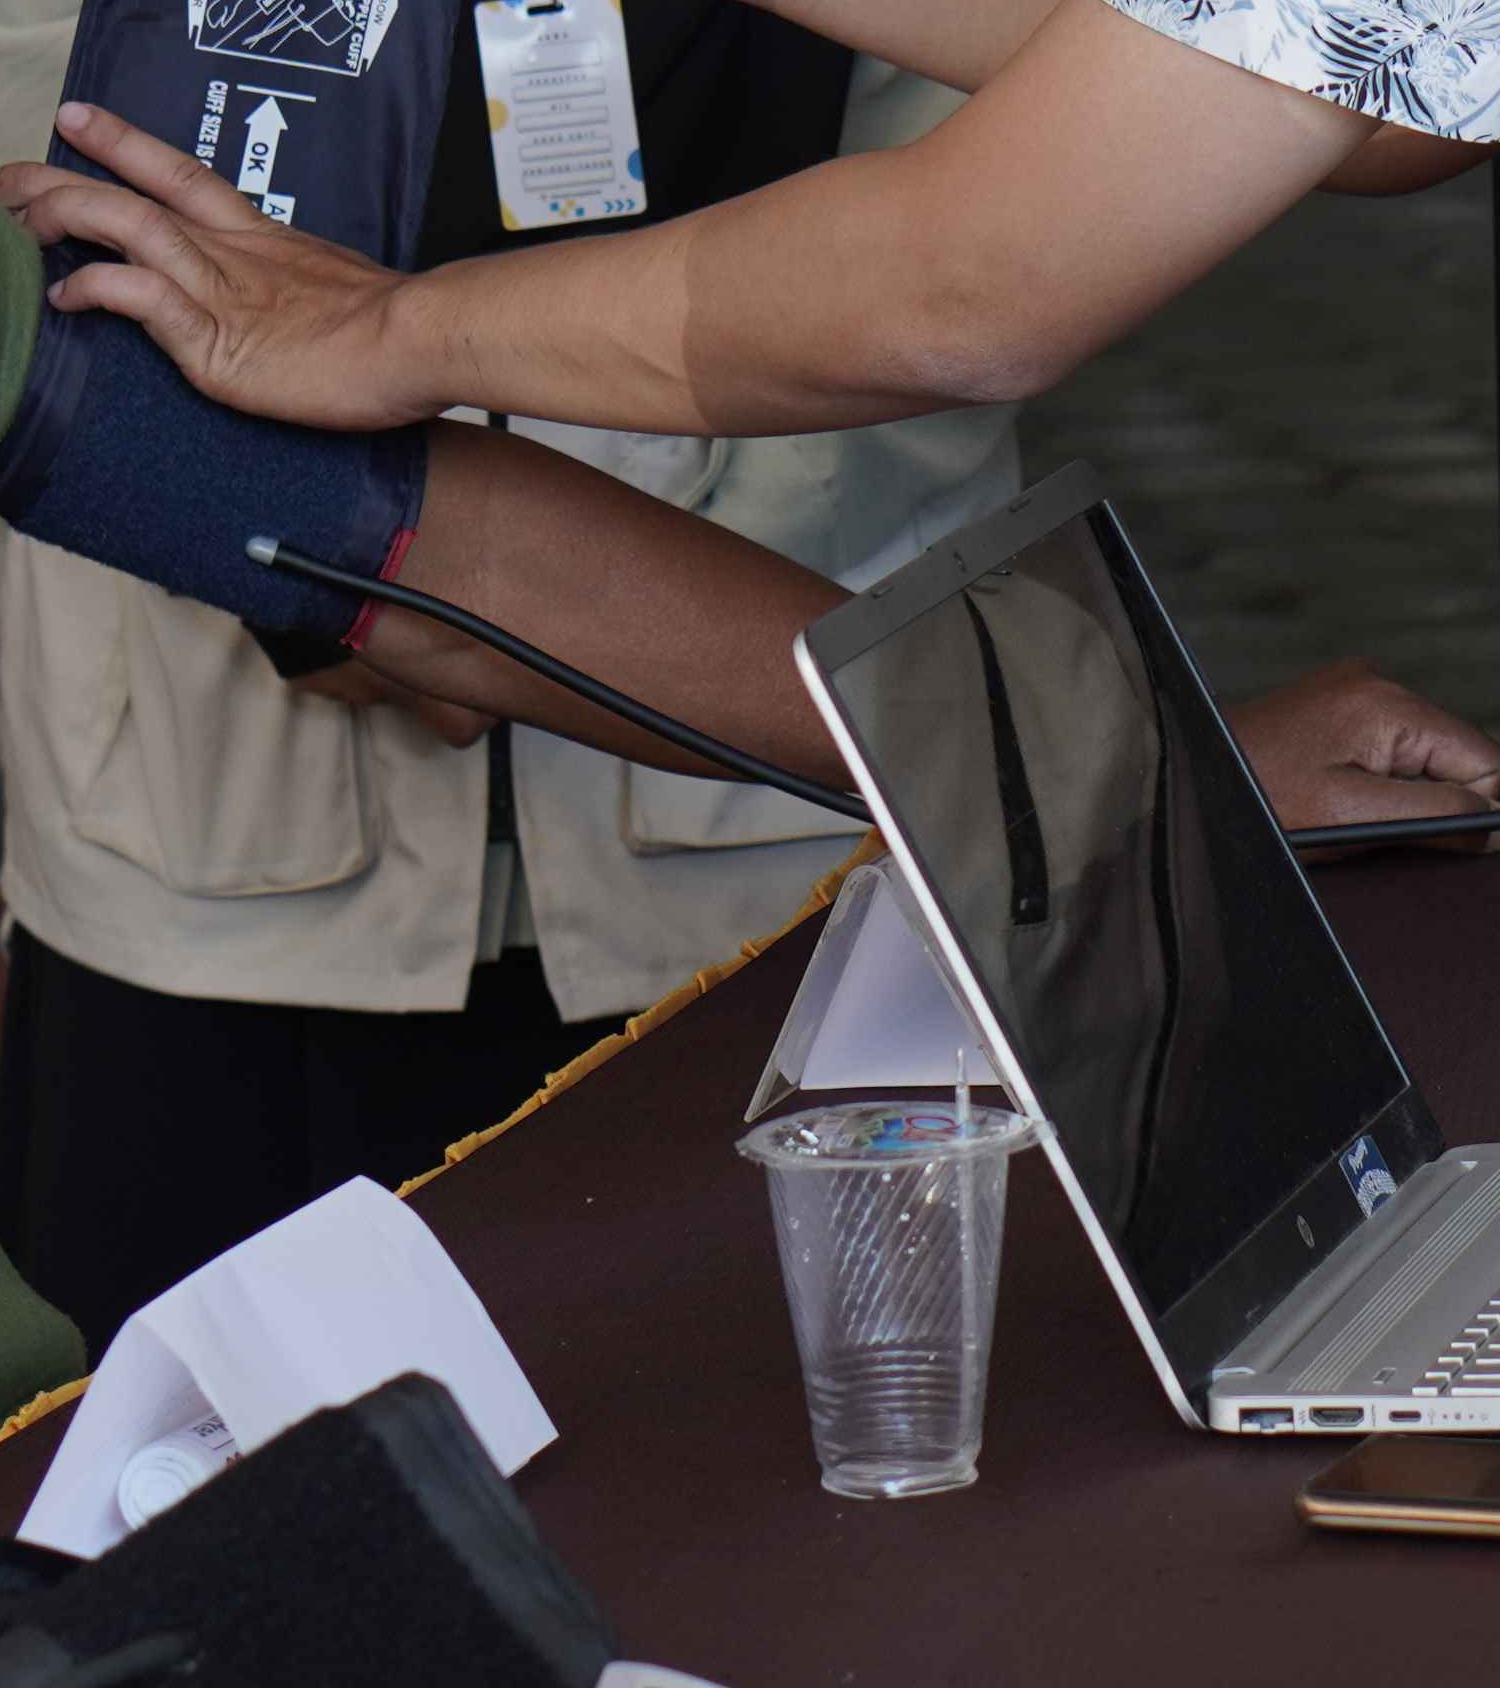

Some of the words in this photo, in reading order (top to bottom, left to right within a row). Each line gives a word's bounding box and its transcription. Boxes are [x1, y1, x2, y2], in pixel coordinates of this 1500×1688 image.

[347, 32, 364, 70] CUFF
[205, 80, 229, 114] CUFF
[198, 114, 222, 144] SIZE
[195, 144, 216, 158] IS
[247, 141, 269, 173] OK
